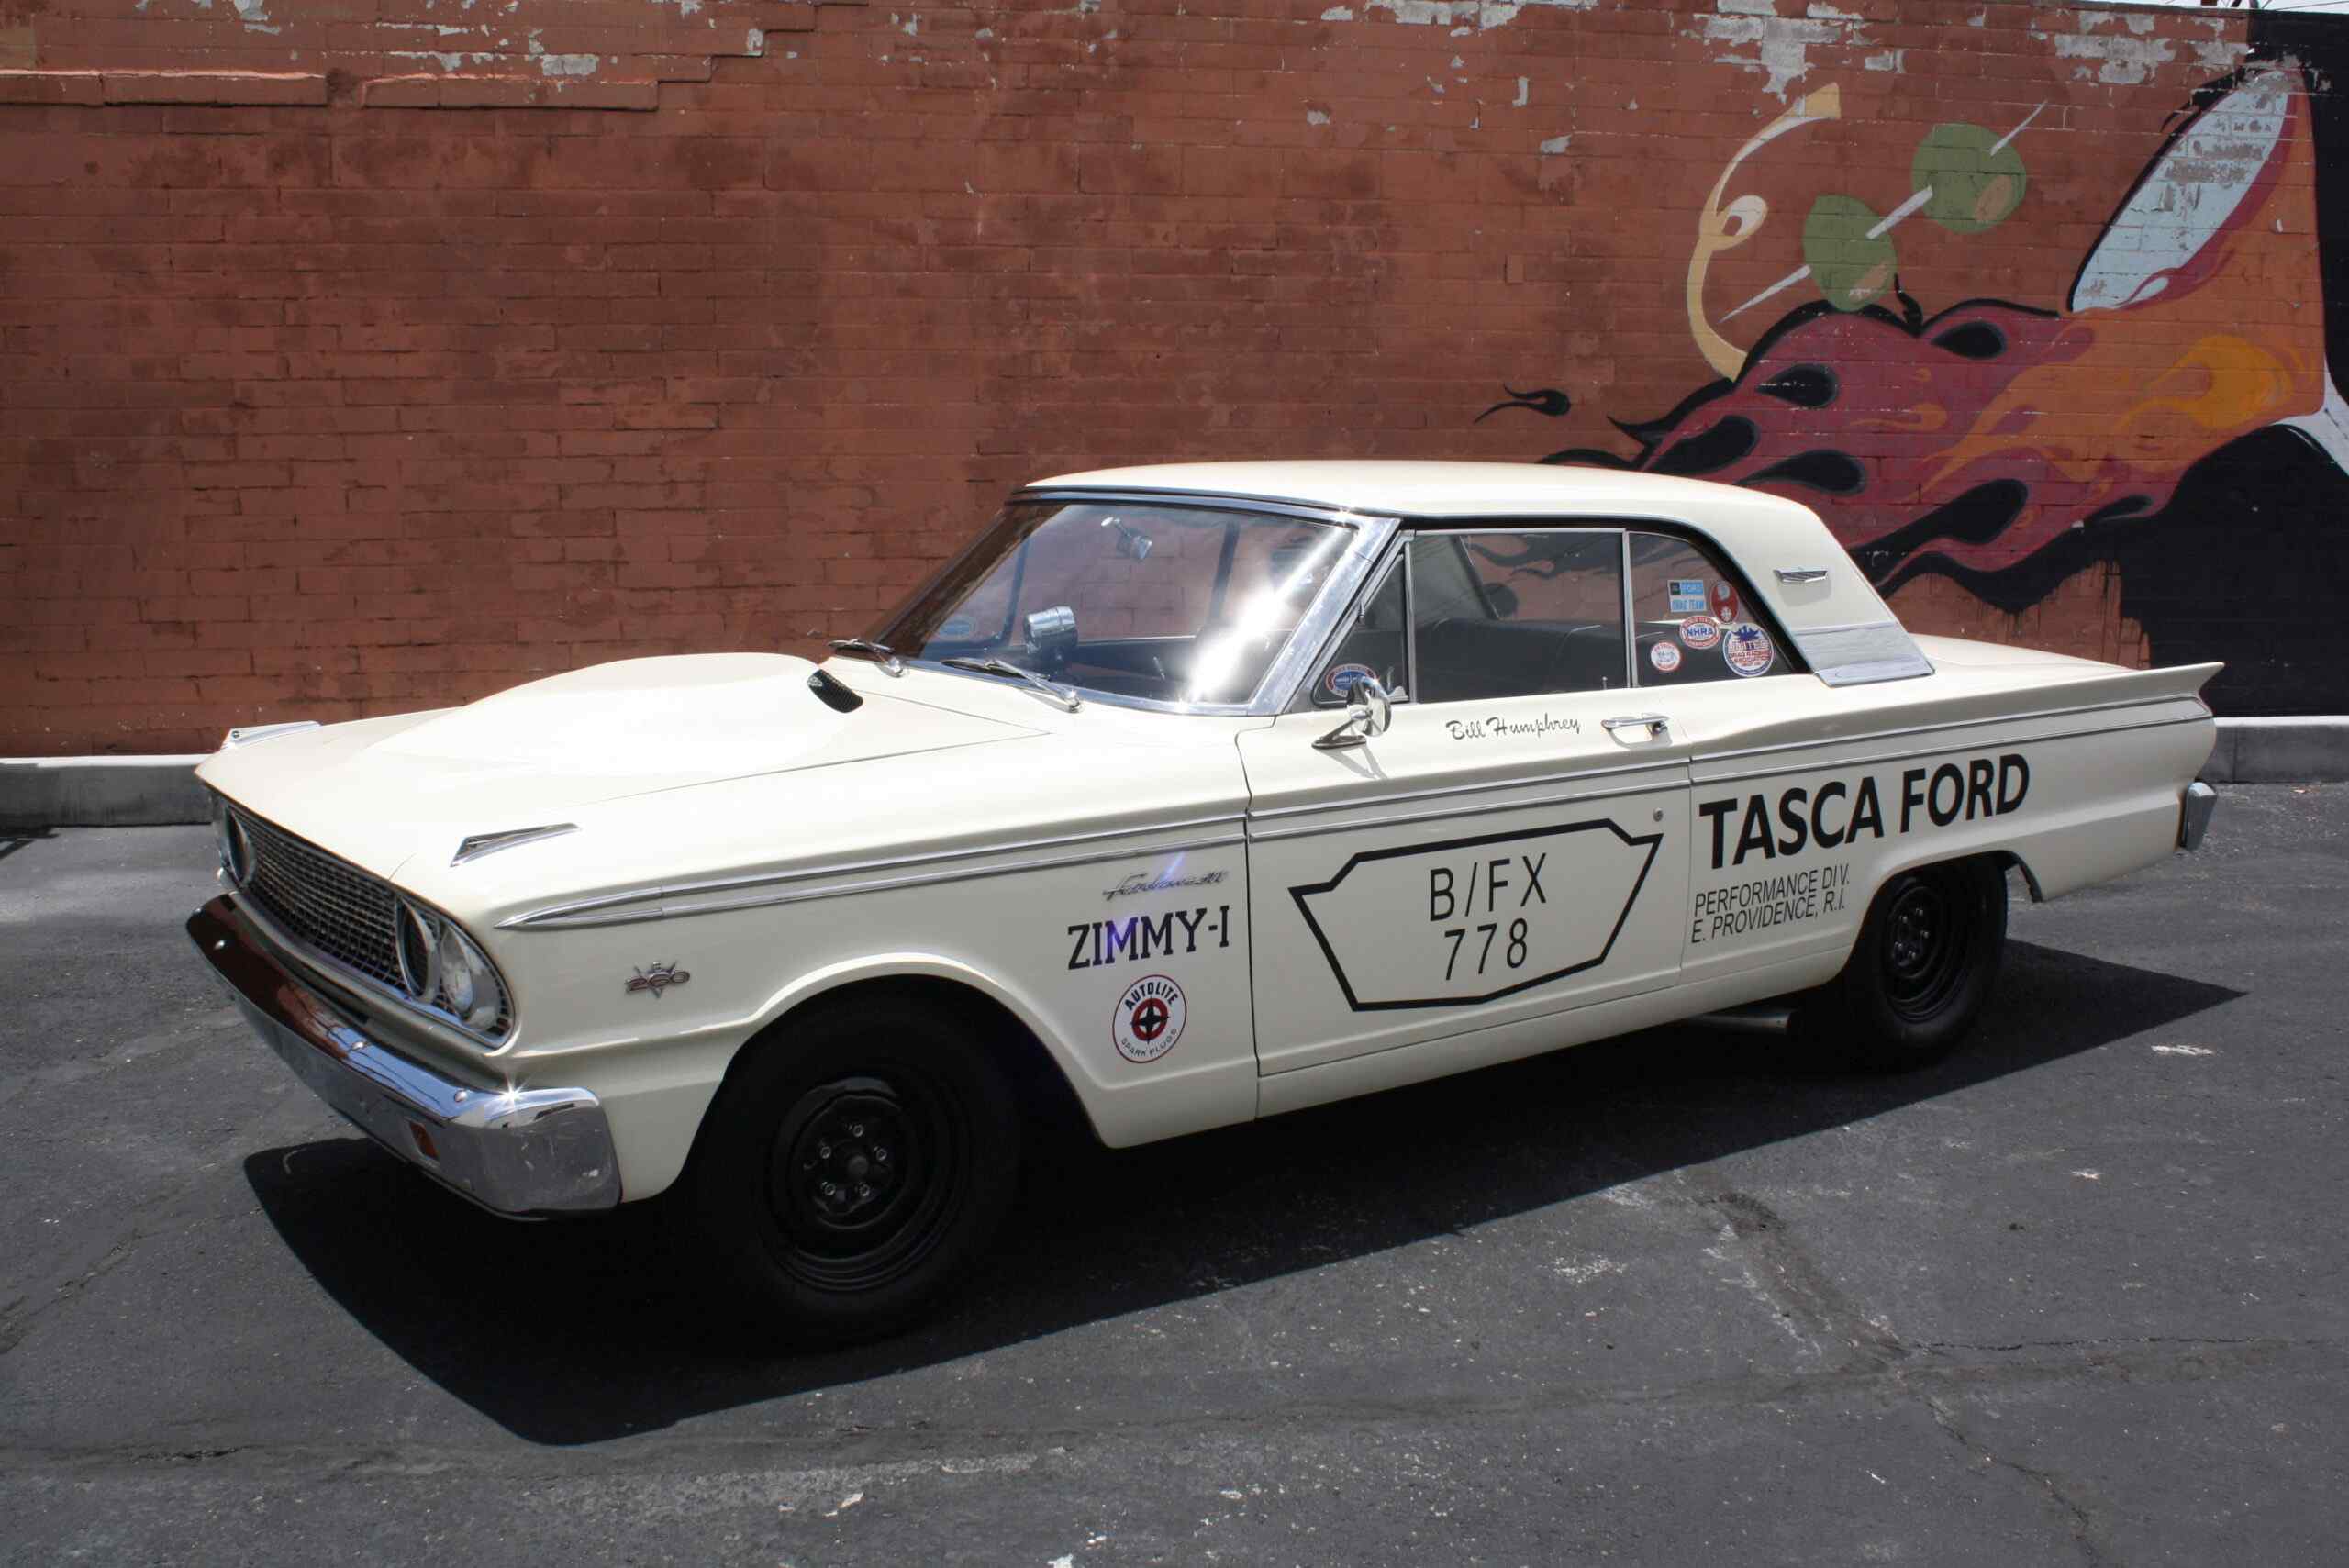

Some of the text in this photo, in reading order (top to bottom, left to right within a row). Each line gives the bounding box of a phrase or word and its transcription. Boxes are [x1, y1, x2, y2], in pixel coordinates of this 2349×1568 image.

[1446, 712, 1581, 740] Bill Humphrey
[1698, 753, 2030, 870] TASCA FORD
[1430, 853, 1547, 921] B/FX
[1694, 864, 1850, 917] PERFORMANCE DIV.
[1068, 905, 1230, 970] ZIMMY-I
[1691, 890, 1845, 943] E. PROVIDENCE, R.I.
[1444, 918, 1529, 980] 778
[1124, 982, 1178, 1010] AUTOLITE
